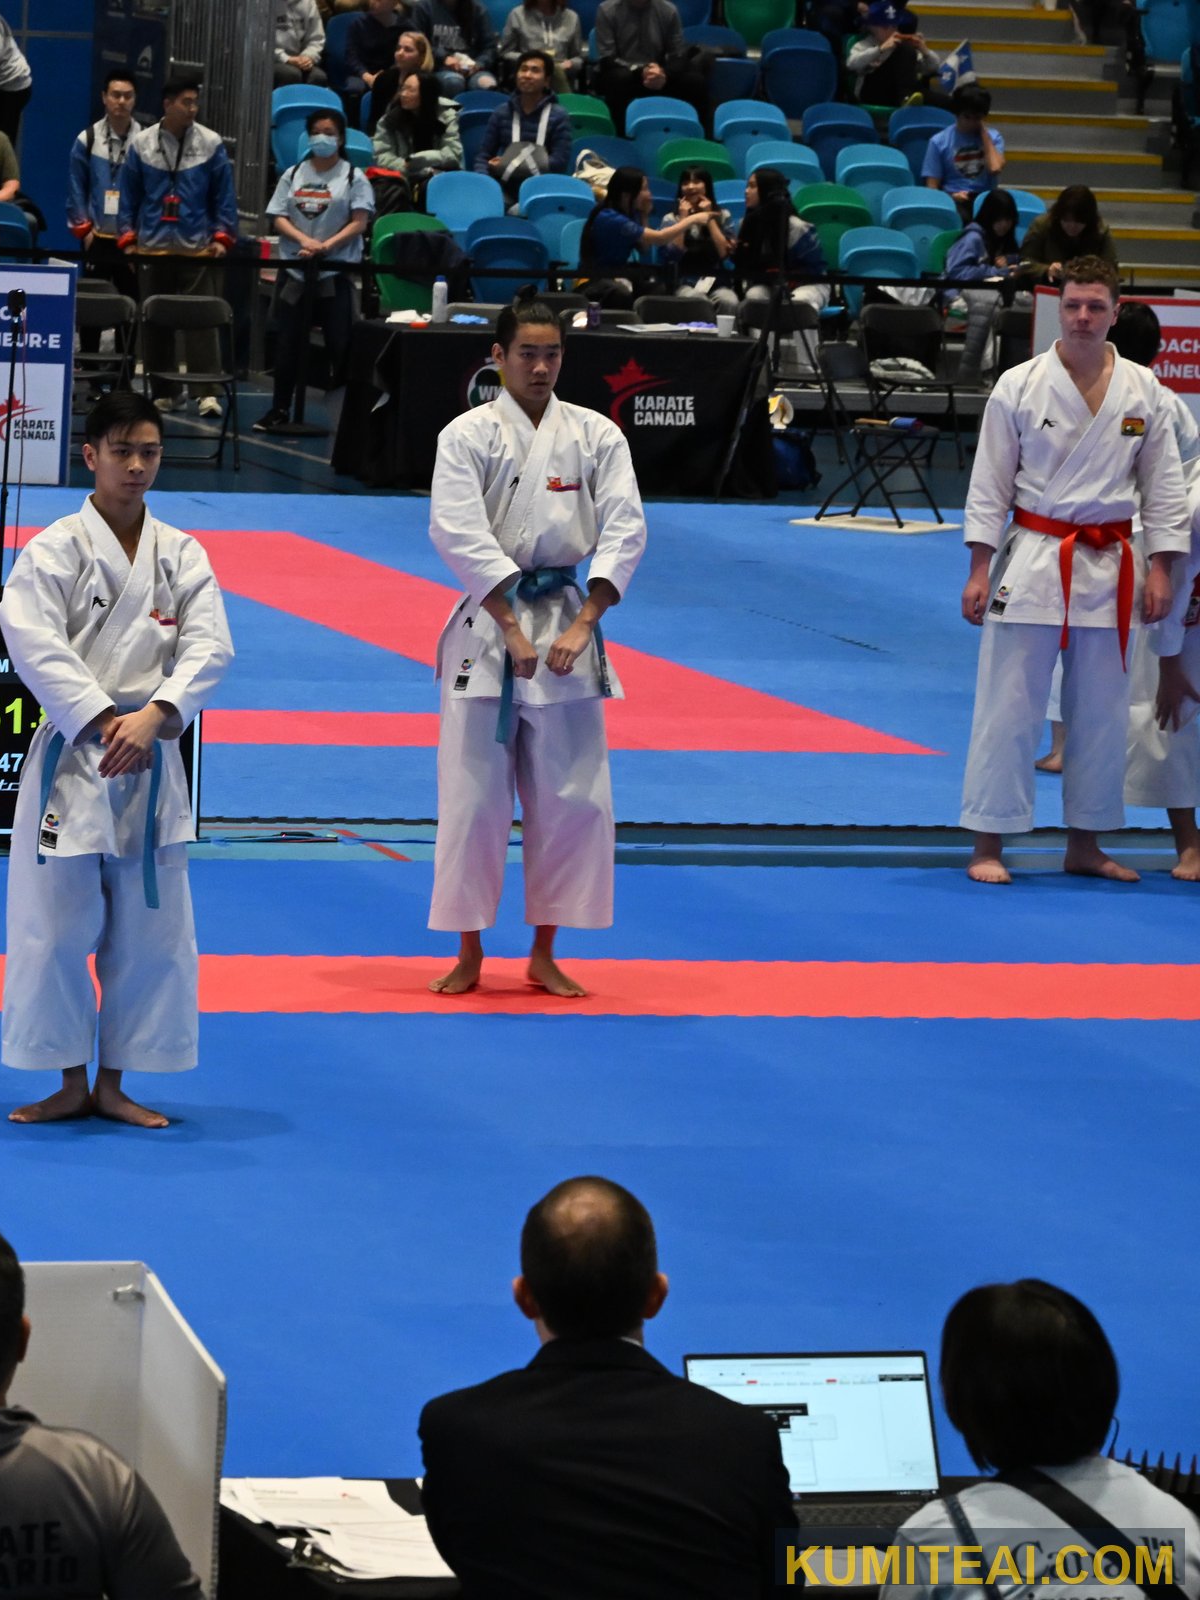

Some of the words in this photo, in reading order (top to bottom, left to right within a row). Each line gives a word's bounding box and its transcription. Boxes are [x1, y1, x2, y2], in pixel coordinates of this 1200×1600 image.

[479, 385, 505, 401] WK
[634, 396, 695, 411] KARATE
[14, 419, 55, 430] KARATE
[634, 412, 696, 426] CANADA
[13, 430, 55, 440] CANADA
